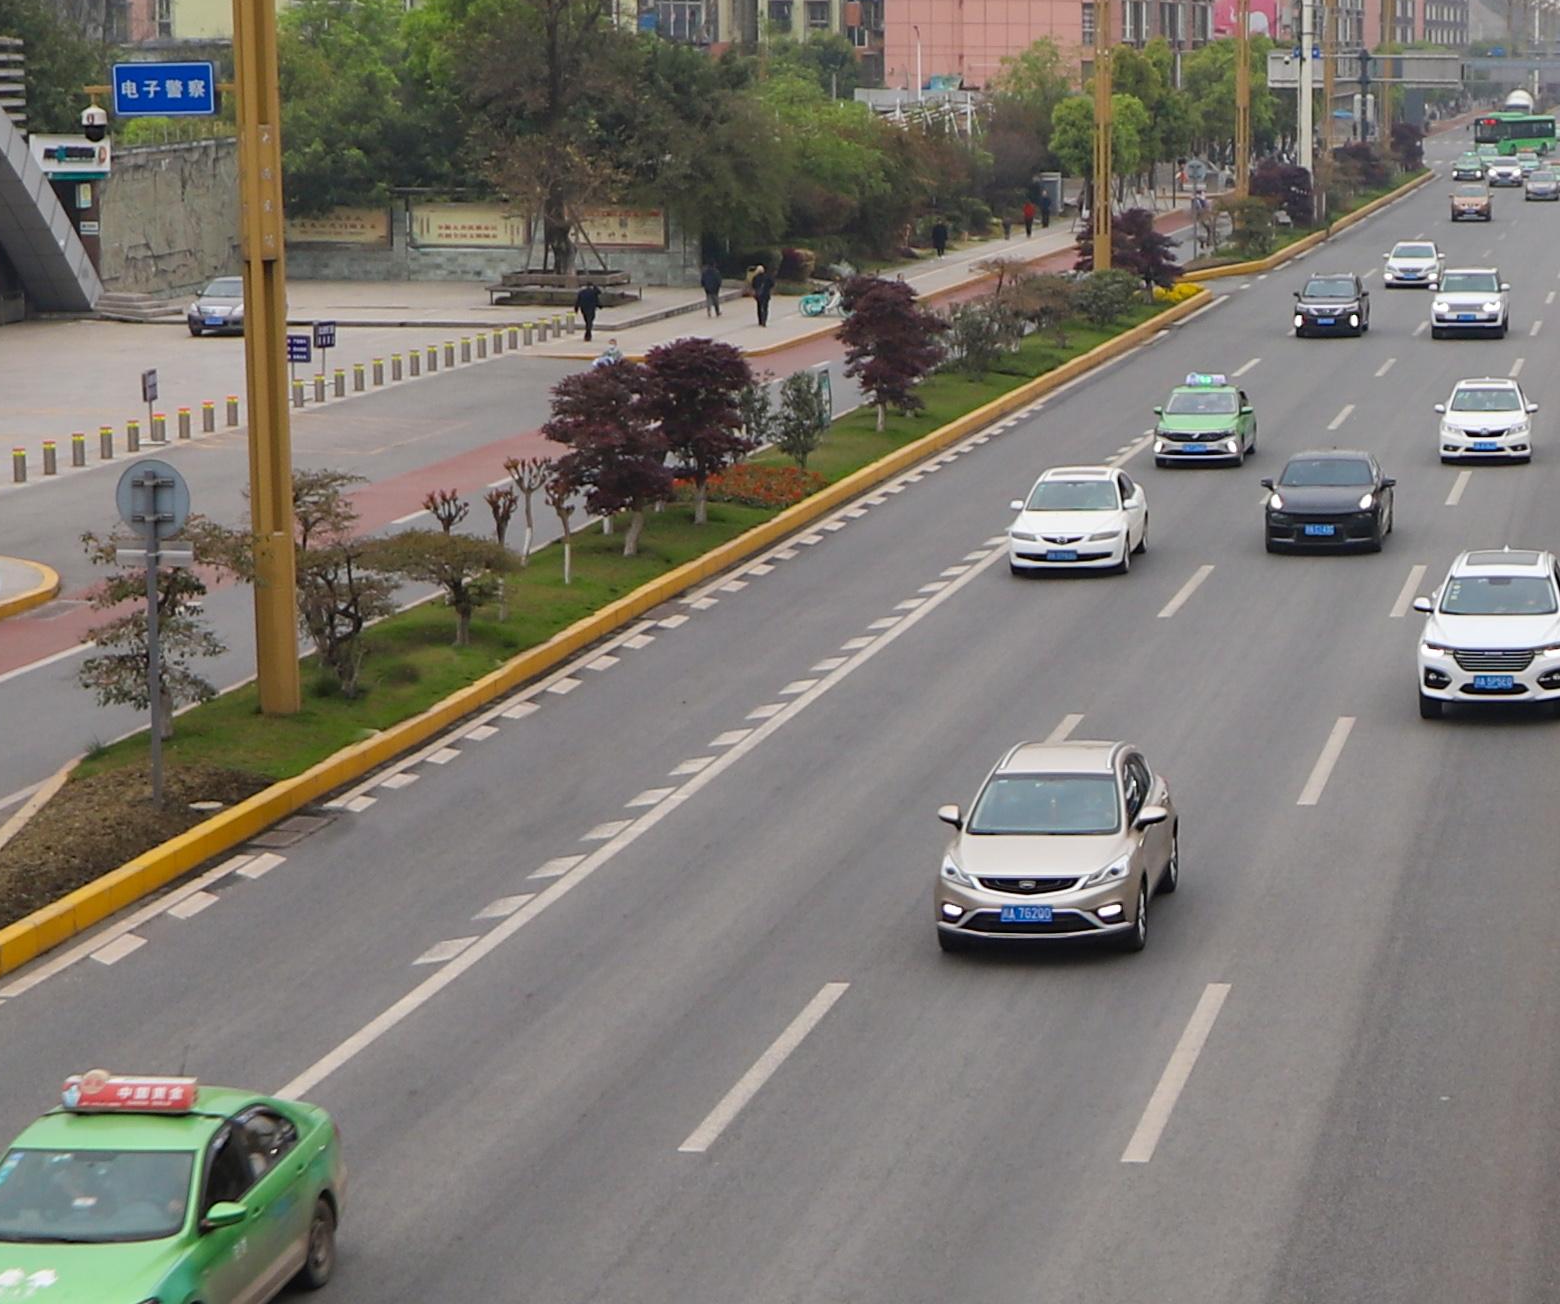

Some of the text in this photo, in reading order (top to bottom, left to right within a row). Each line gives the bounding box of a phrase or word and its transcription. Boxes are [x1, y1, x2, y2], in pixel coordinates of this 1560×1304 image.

[121, 79, 206, 98] 电子警察
[116, 1086, 185, 1101] 中国黄金
